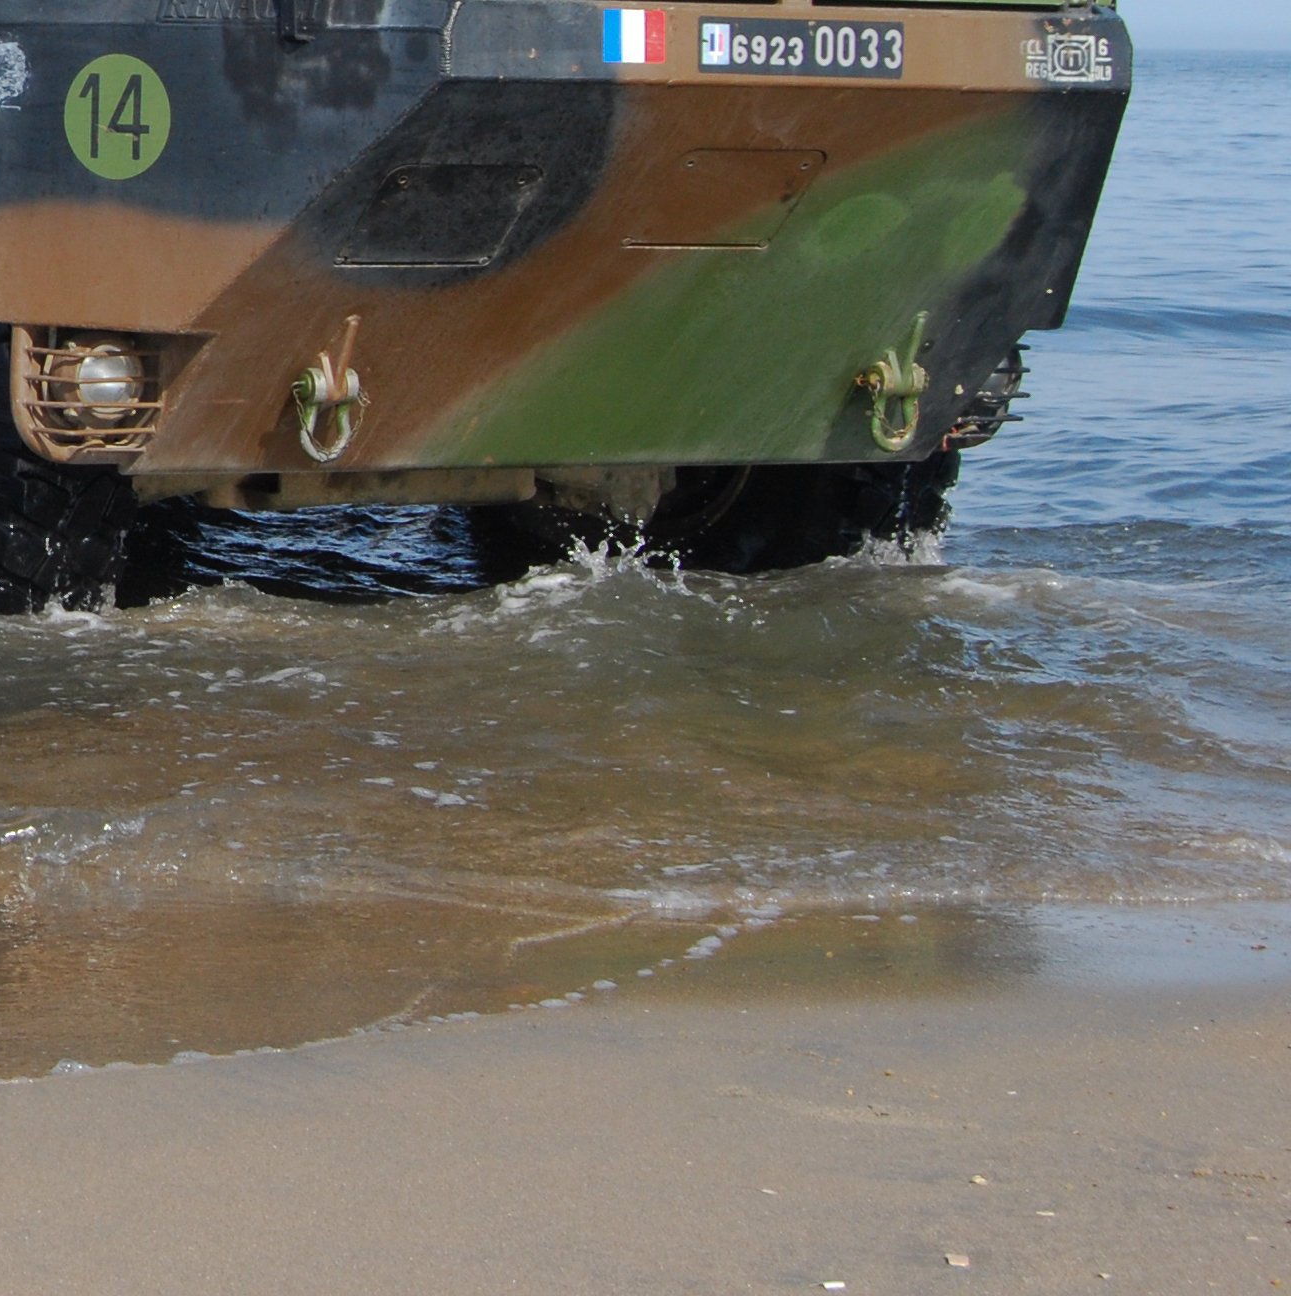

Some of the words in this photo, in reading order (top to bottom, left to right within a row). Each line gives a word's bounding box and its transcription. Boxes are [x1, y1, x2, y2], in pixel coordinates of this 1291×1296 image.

[732, 34, 804, 66] 6923
[815, 26, 903, 69] 0033
[1098, 38, 1109, 56] 6
[1025, 62, 1048, 79] REG
[79, 73, 150, 160] 14
